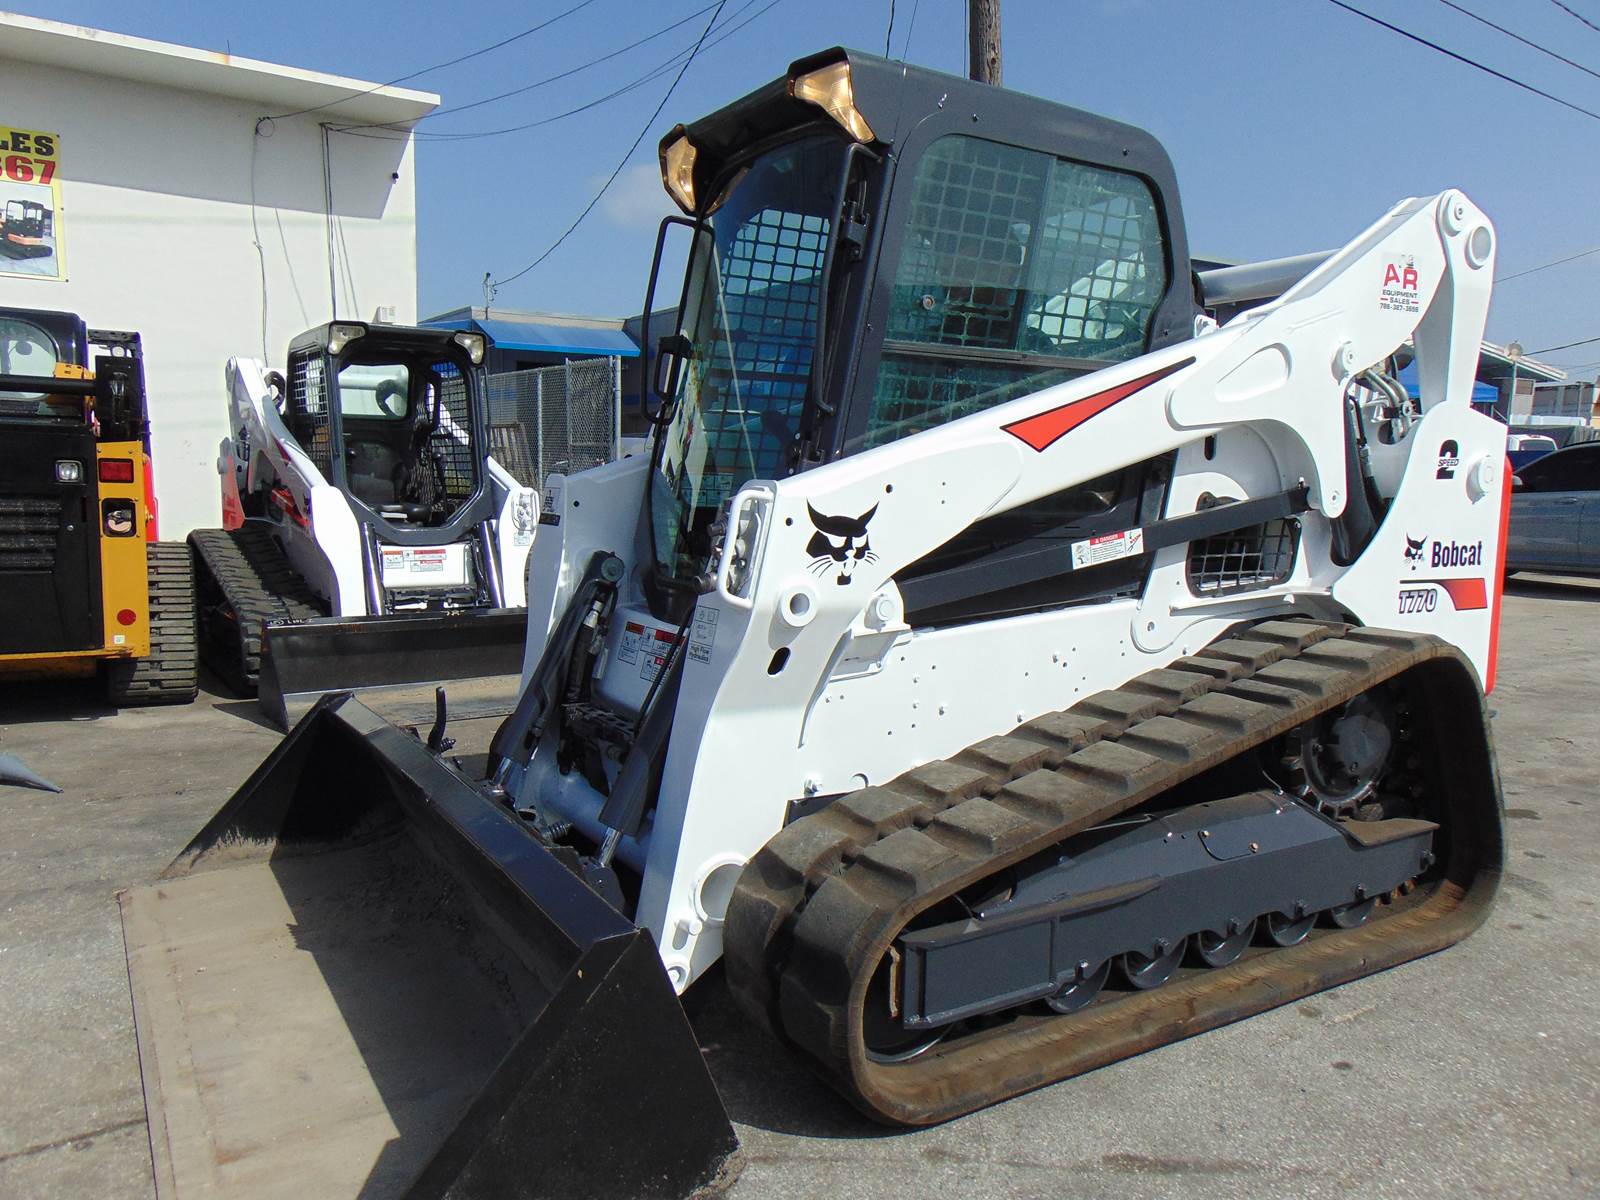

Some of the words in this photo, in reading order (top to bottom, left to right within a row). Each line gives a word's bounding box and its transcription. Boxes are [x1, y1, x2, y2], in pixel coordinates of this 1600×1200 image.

[0, 155, 56, 184] 67
[1384, 263, 1418, 290] AR
[1382, 290, 1418, 298] EQUIPMENT
[1390, 297, 1410, 305] SALES
[1436, 439, 1458, 480] 2
[1438, 459, 1459, 467] SPEED
[1099, 533, 1119, 542] DANGER
[1431, 540, 1482, 568] Bobcat
[1399, 589, 1437, 614] T770
